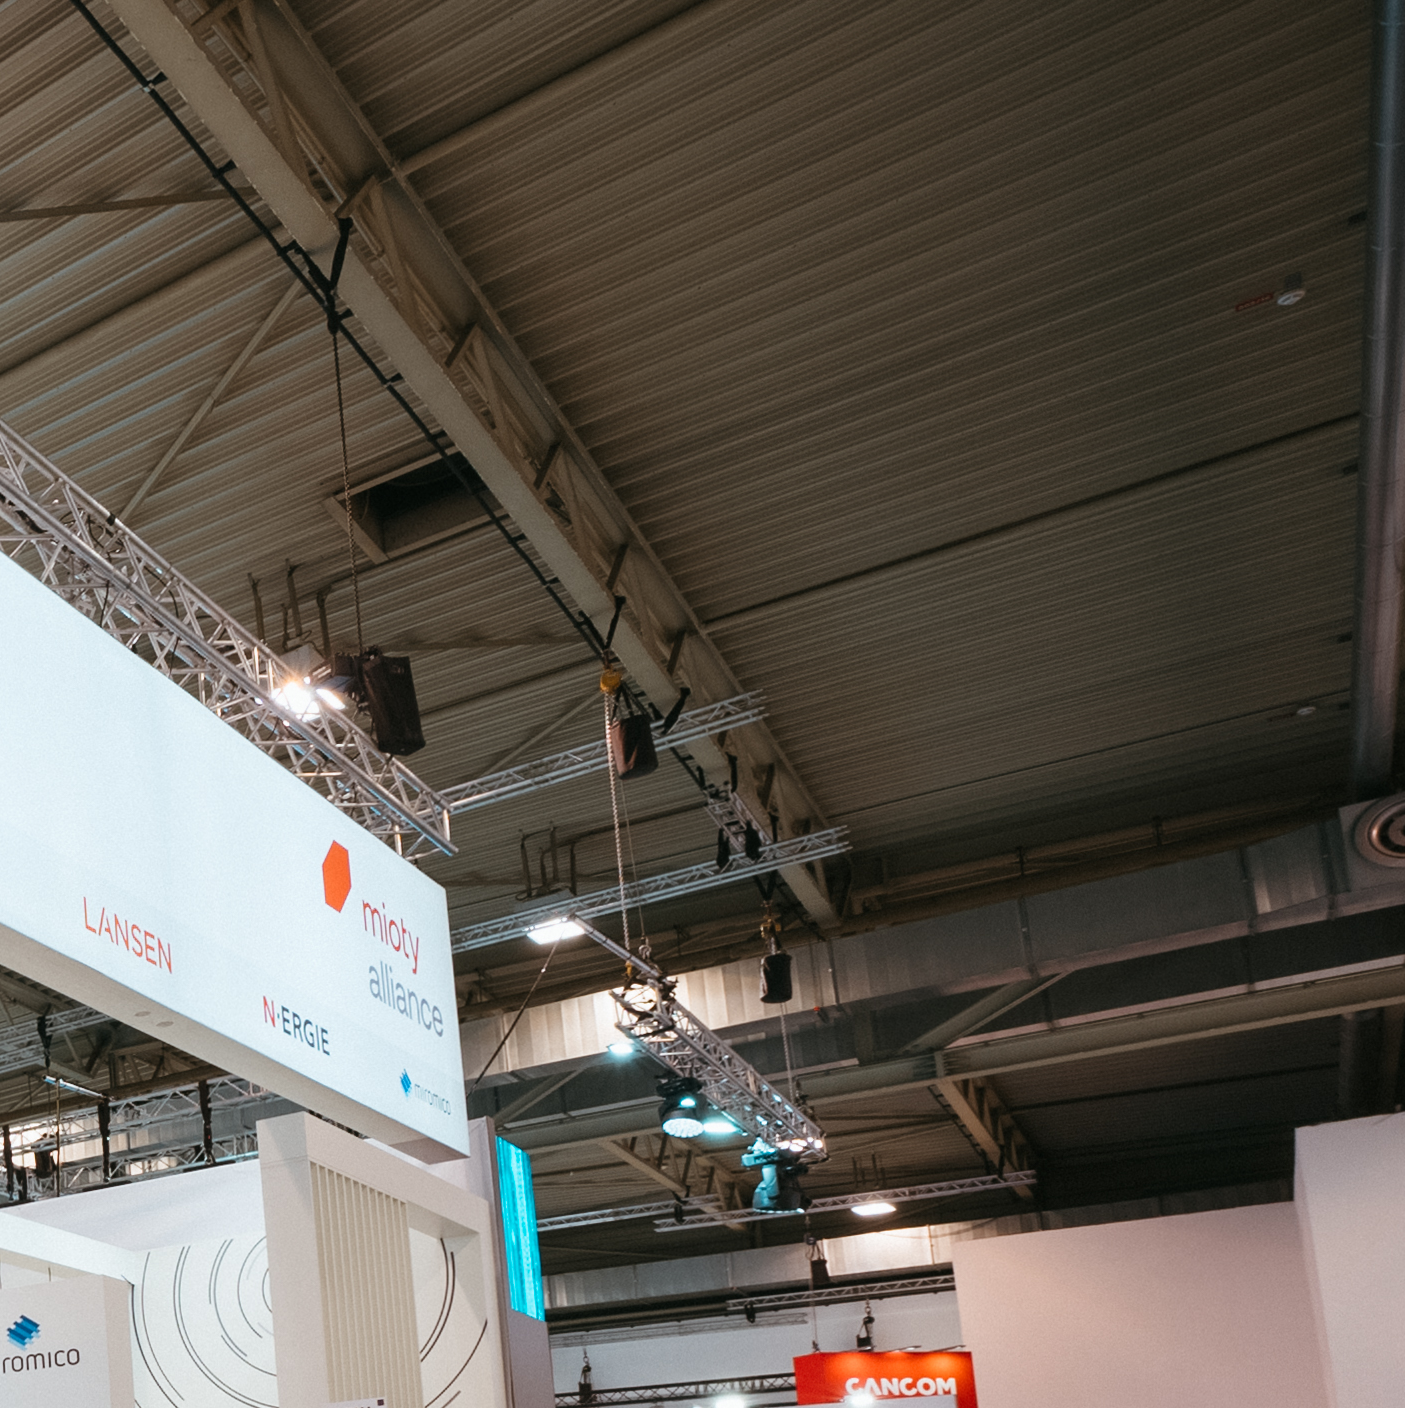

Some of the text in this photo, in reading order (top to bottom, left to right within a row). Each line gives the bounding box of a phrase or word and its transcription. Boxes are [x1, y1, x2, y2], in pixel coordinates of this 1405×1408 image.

[83, 896, 173, 975] LANSEN
[362, 899, 419, 975] mioty
[368, 960, 444, 1037] alliance
[414, 1083, 452, 1115] miromico
[845, 1377, 957, 1396] CANCOM
